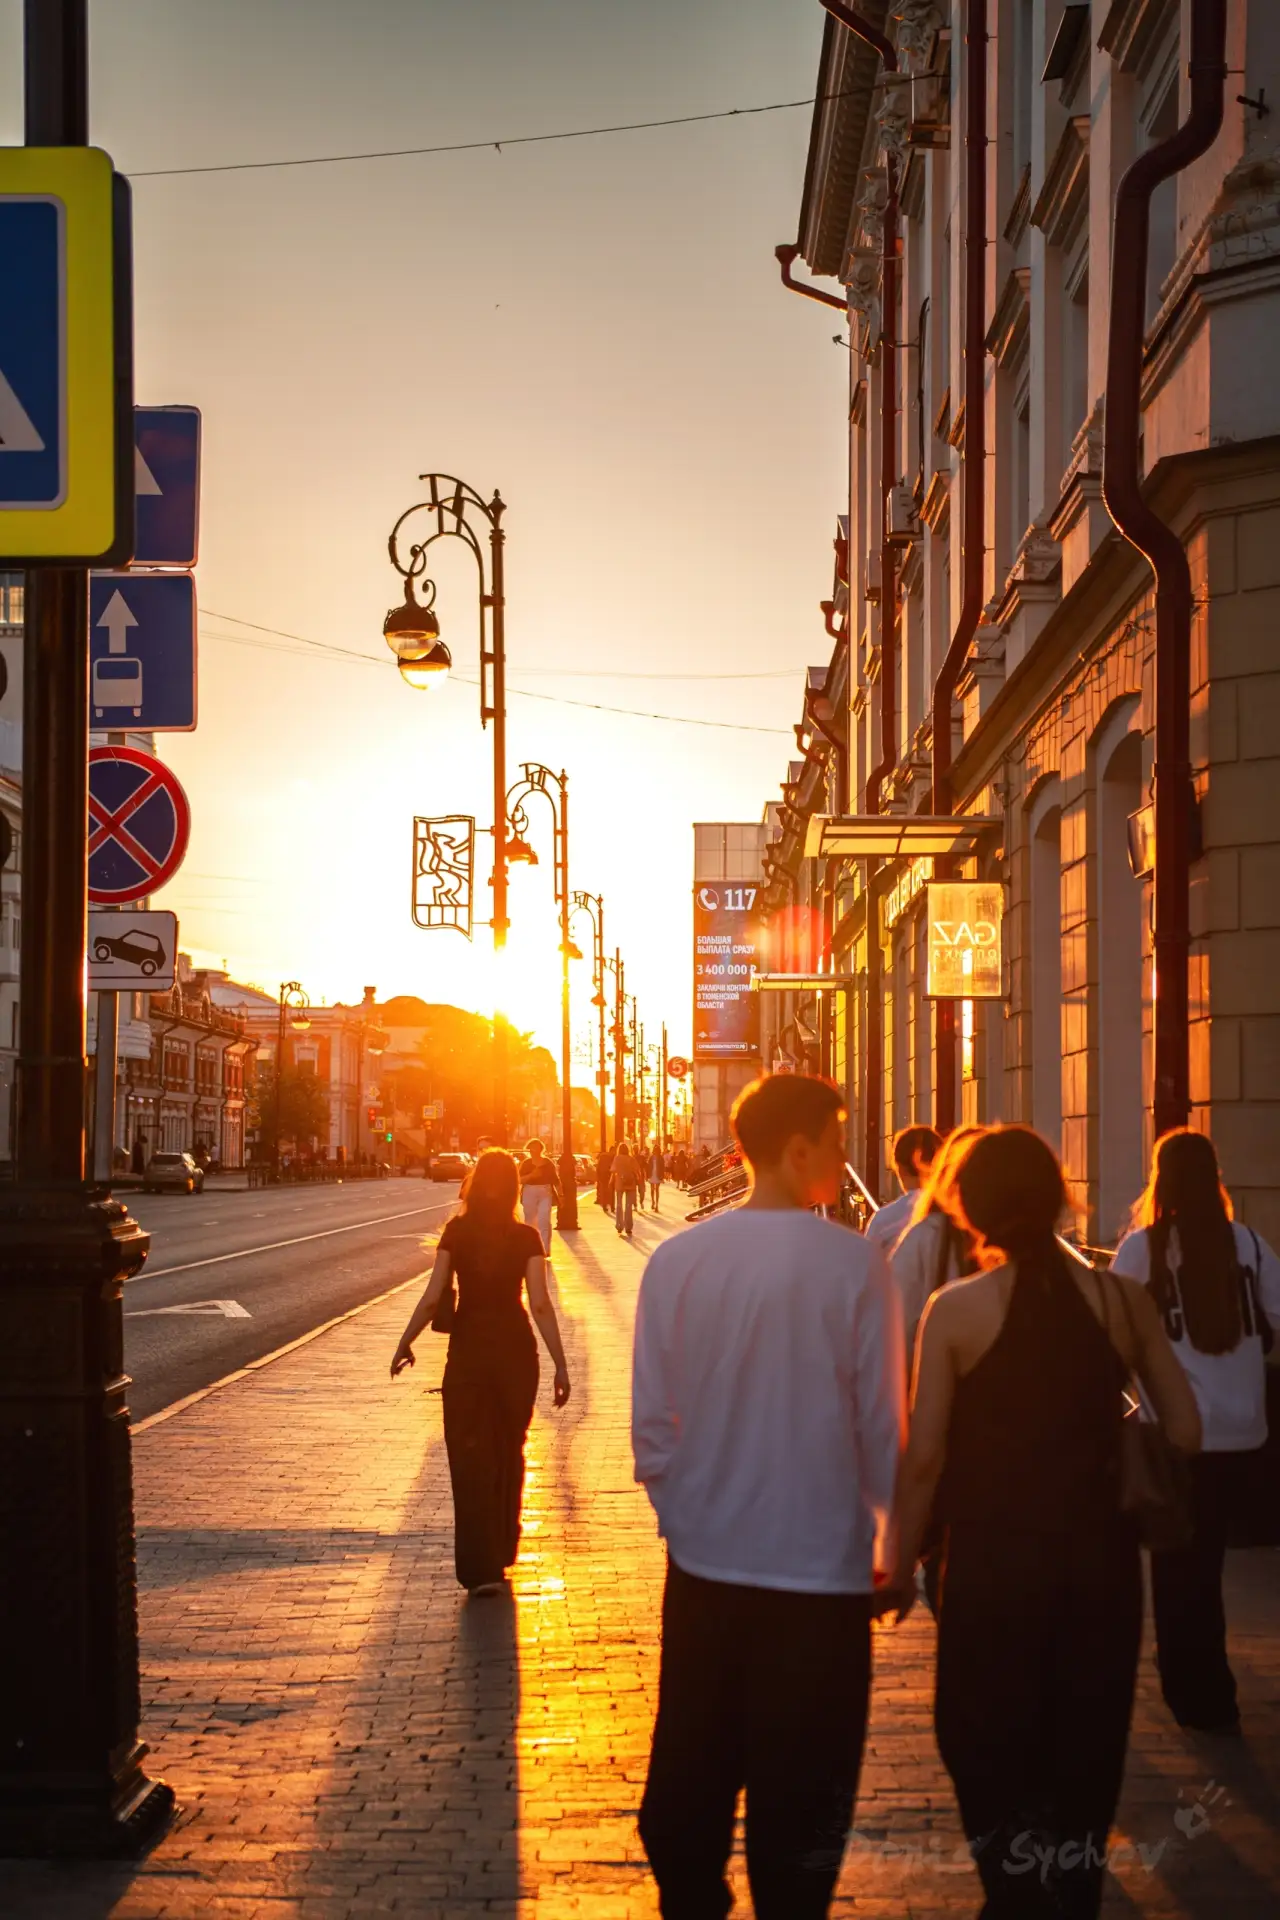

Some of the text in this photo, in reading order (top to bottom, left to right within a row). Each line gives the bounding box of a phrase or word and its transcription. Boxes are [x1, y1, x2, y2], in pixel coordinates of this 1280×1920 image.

[724, 888, 757, 911] 117
[697, 935, 732, 945] БОЛЬШАЯ
[697, 944, 755, 954] ВЫПЛАТА СРАЗУ
[696, 964, 703, 975] 3
[705, 964, 725, 975] 400
[727, 964, 748, 975] 000
[697, 984, 726, 992] ЗАКЛЮЧИ
[697, 991, 740, 1000] В ТЮМЕНСКОЙ
[697, 1001, 725, 1009] ОБЛАСТИ
